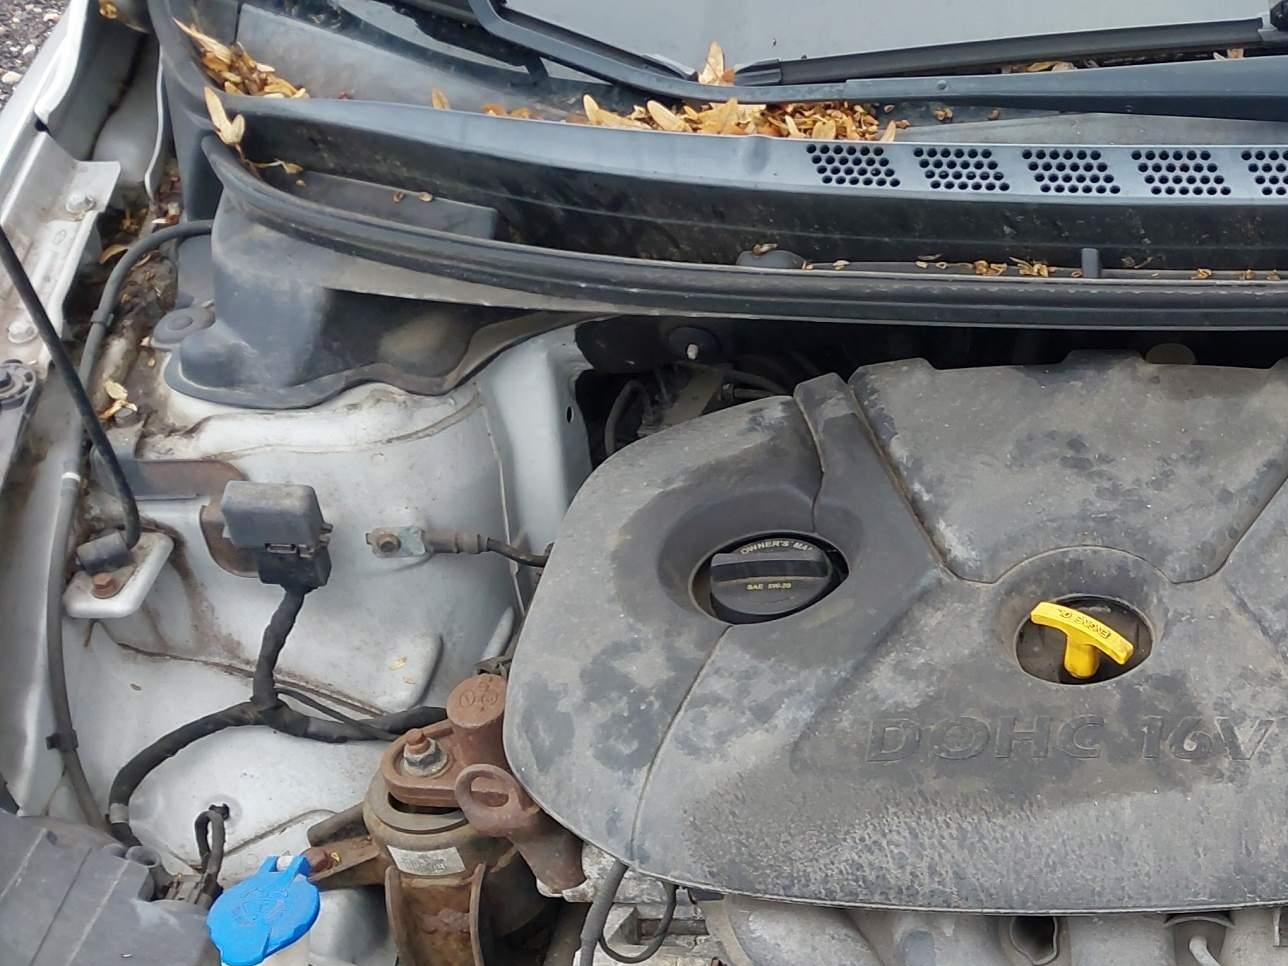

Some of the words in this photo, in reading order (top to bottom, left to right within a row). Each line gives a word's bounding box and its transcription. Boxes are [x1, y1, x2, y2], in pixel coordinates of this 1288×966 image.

[740, 540, 790, 555] OWNER'S
[746, 583, 764, 591] SAE
[865, 714, 1104, 764] DOHC
[1140, 715, 1277, 761] 16V
